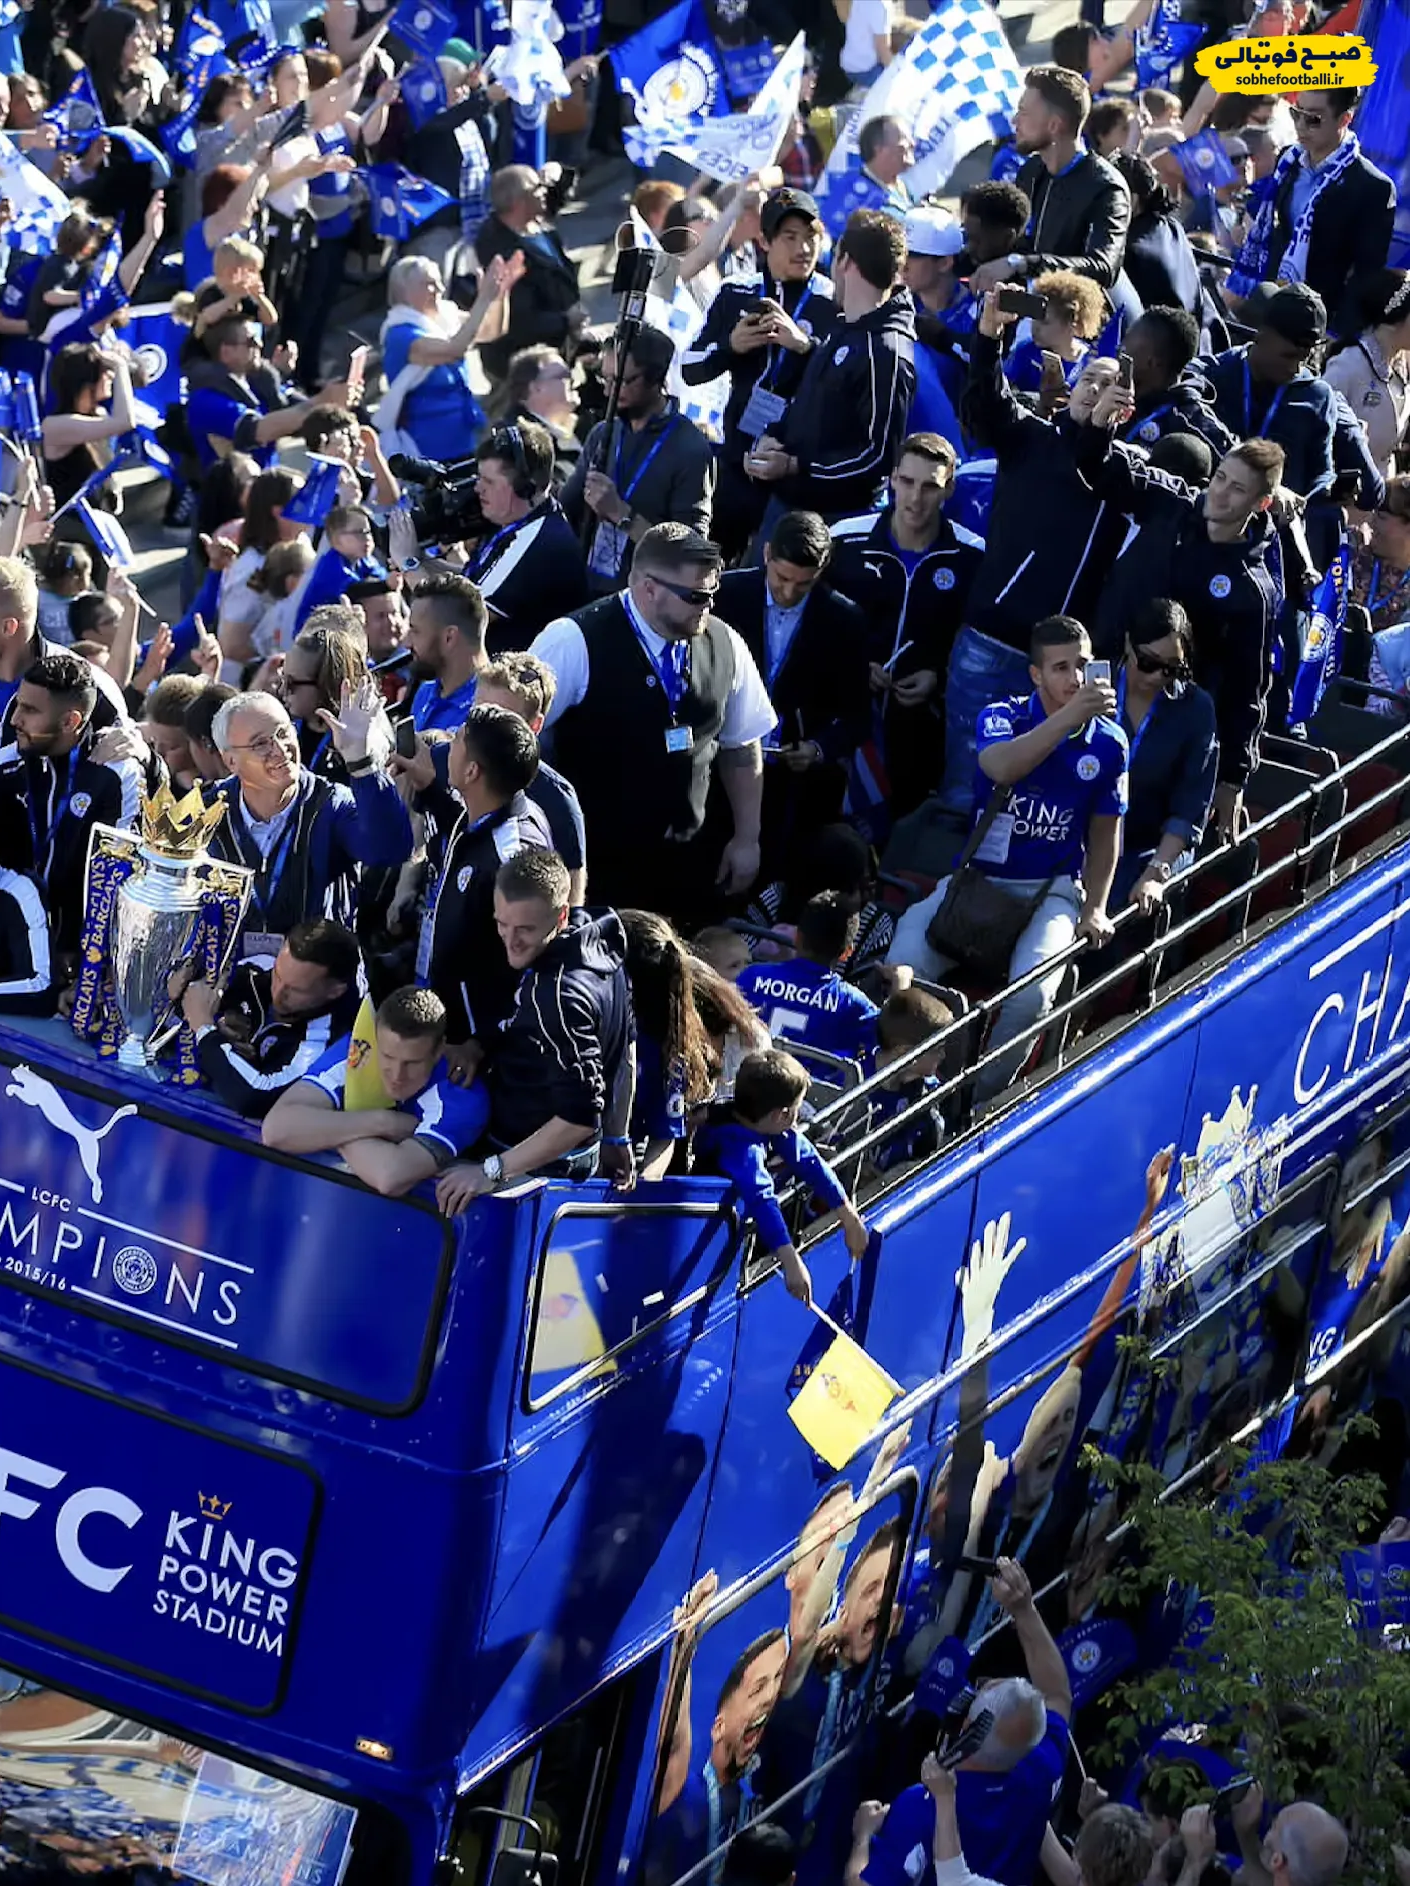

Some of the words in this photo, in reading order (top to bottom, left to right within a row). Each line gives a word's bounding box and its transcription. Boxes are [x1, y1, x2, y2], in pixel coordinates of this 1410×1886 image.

[1007, 793, 1074, 825] KING
[1014, 820, 1070, 841] OWER
[92, 867, 124, 946] BARCLAYS
[205, 924, 220, 984] RCLAYS
[753, 976, 839, 1012] MORGAN
[31, 1187, 72, 1213] LCFC
[4, 1256, 68, 1291] 2015/16
[165, 1511, 298, 1589] KING
[157, 1554, 289, 1627] POWER
[152, 1588, 284, 1657] STADIUM
